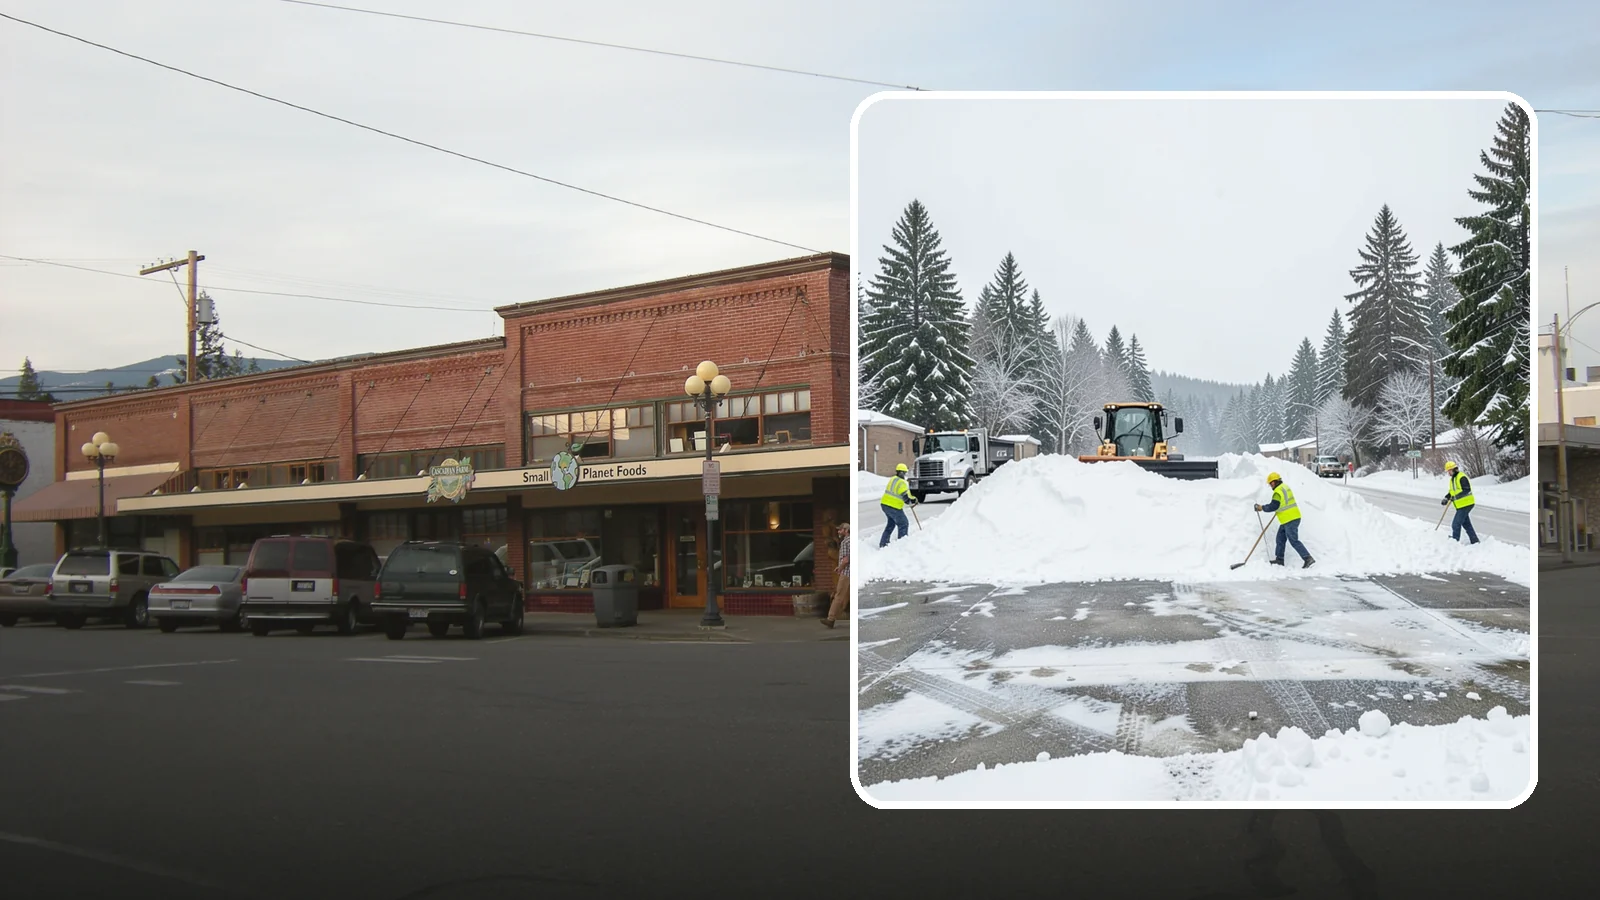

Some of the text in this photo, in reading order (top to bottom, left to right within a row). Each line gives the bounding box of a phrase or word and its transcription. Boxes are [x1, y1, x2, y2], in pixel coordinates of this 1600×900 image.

[523, 465, 647, 483] Small Planet Foods
